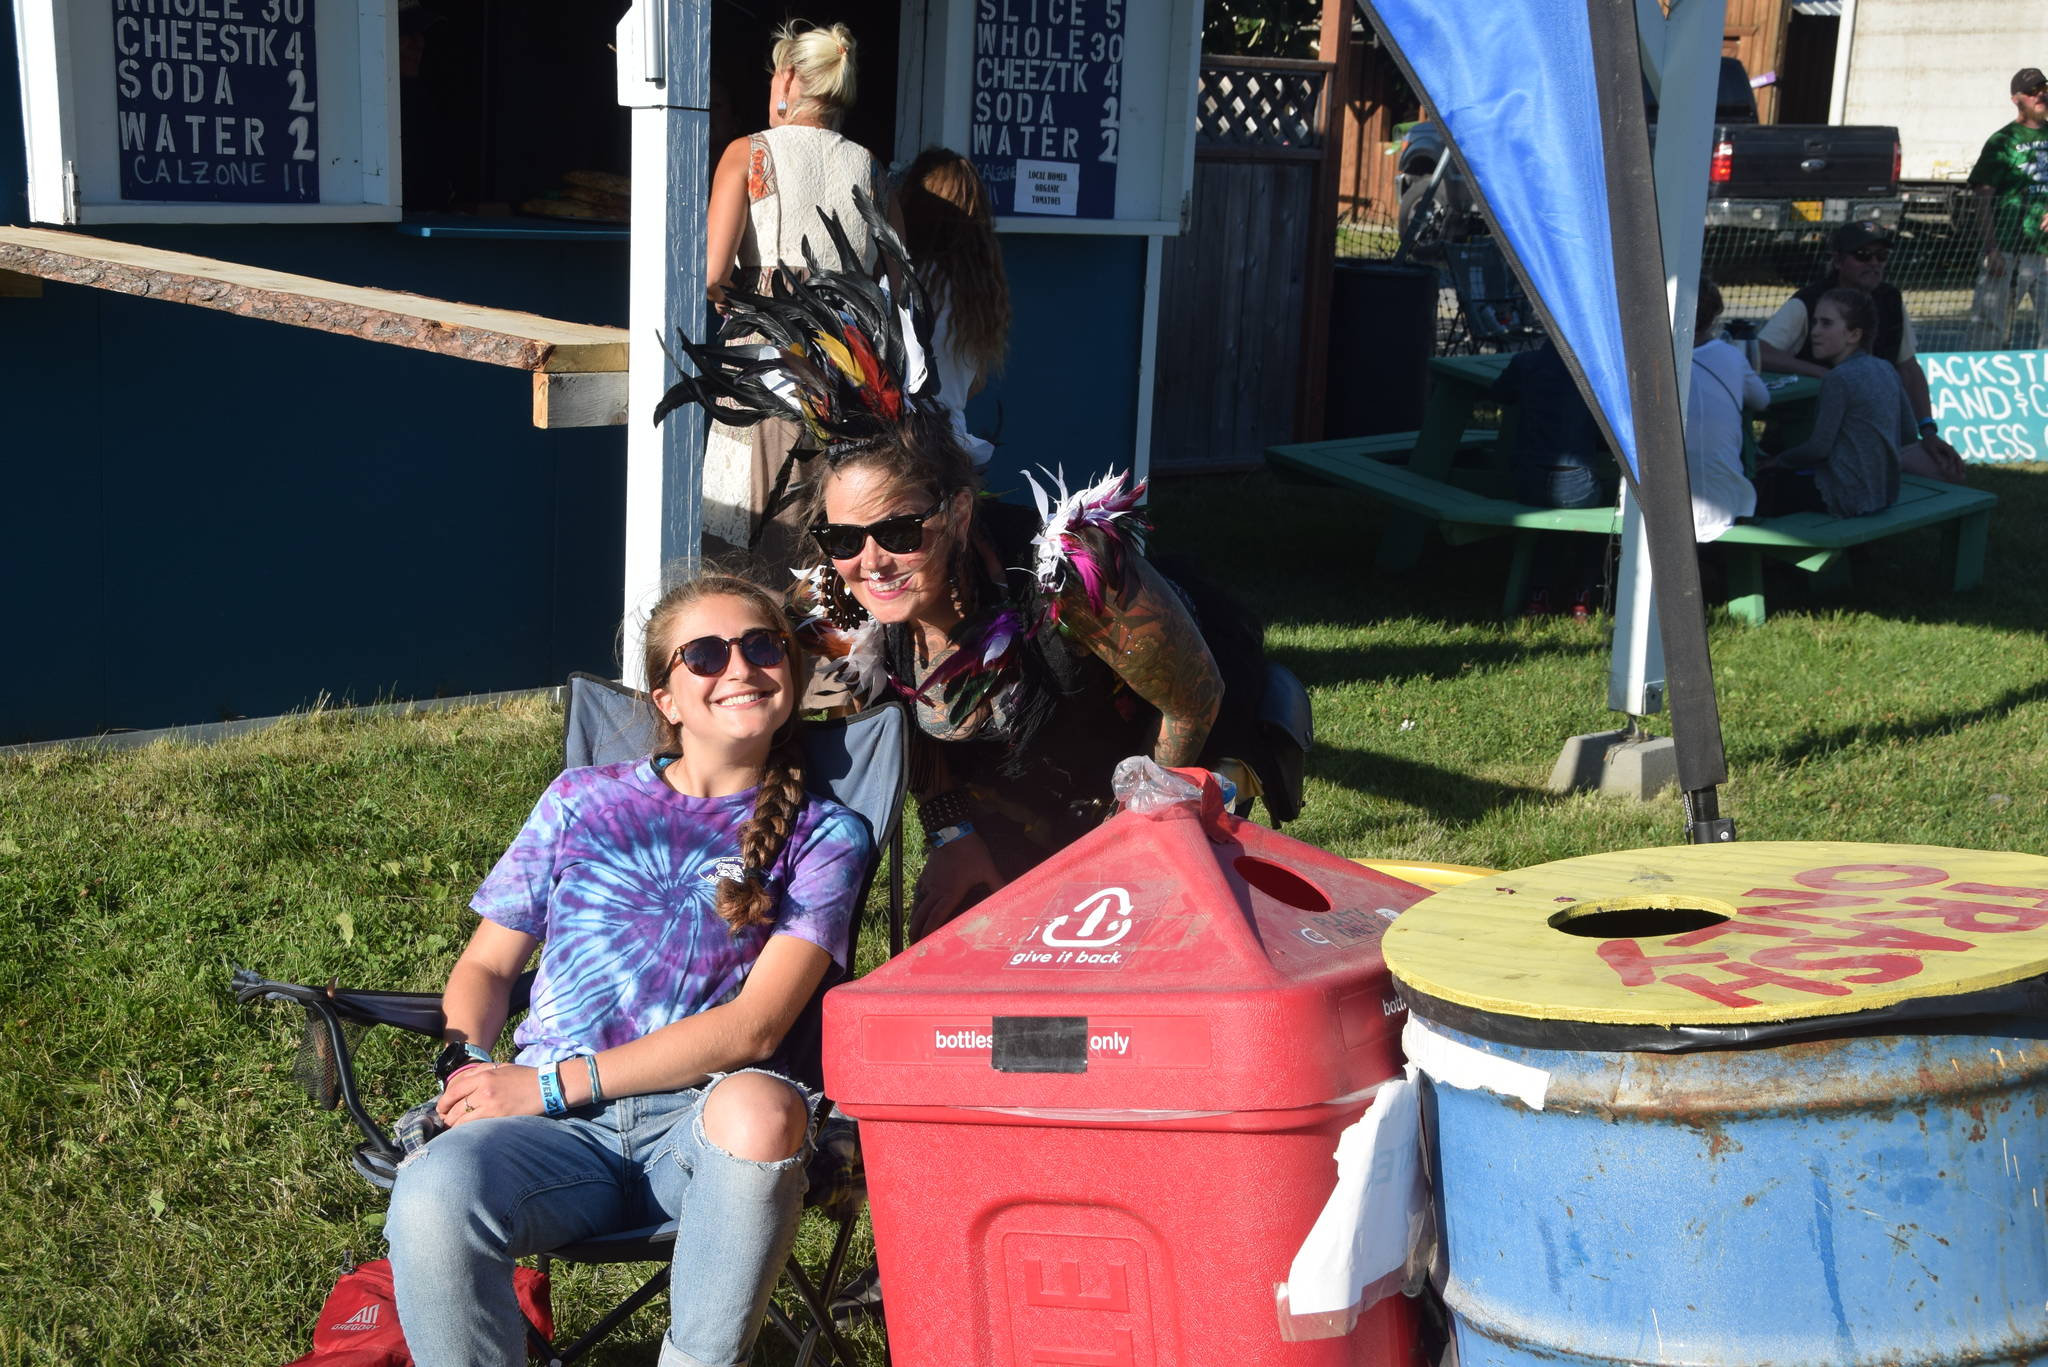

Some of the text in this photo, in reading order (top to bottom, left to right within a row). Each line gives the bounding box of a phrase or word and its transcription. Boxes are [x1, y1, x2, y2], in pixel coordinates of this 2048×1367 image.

[1105, 0, 1121, 29] 5
[116, 16, 304, 69] CHEESTK 4
[977, 23, 1124, 63] WHOLE 30
[118, 59, 316, 112] SODA 2
[976, 58, 1119, 94] CHEEZTK 4
[975, 91, 1120, 128] SODA 2
[119, 111, 316, 161] WATER 2
[973, 124, 1118, 164] WATER 2
[134, 155, 268, 187] CALZONE
[1917, 352, 2048, 387] ACKST
[1009, 950, 1122, 966] give it back
[935, 1030, 1130, 1055] bottles only
[541, 1074, 554, 1098] OVER
